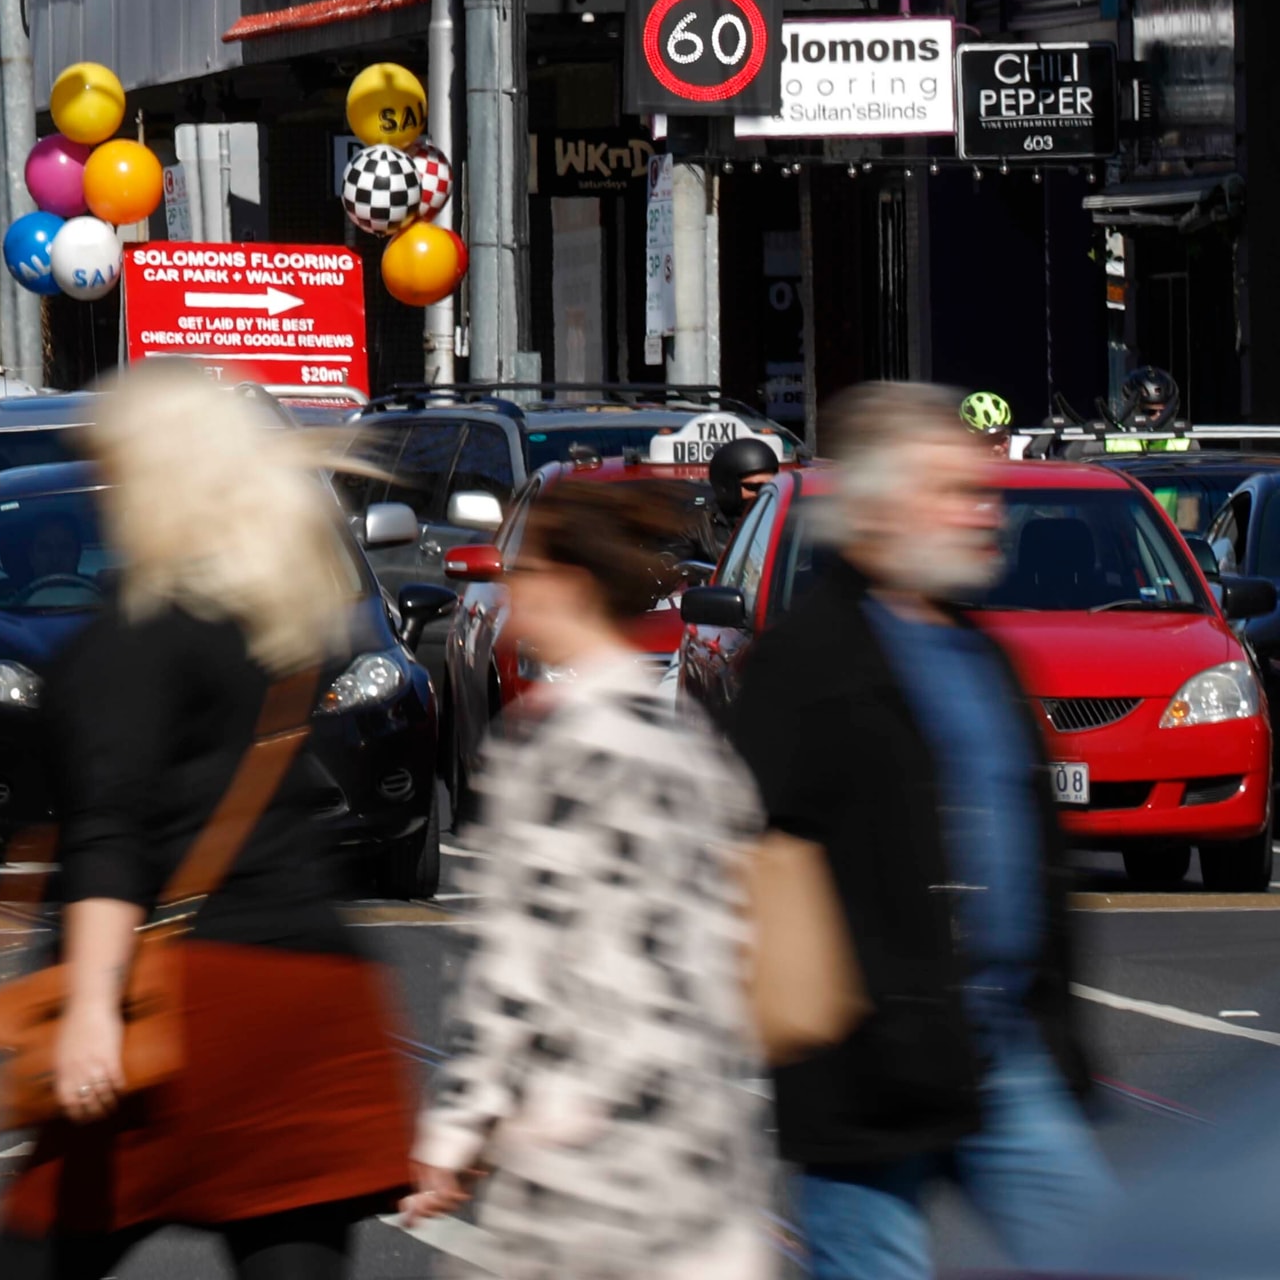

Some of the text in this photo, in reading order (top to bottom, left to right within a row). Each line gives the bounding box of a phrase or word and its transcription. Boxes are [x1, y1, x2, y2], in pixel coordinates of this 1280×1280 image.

[666, 11, 747, 66] 60
[782, 32, 940, 63] lomons
[993, 52, 1079, 85] CHILI
[785, 72, 939, 101] ooring
[979, 86, 1094, 118] PEPPER
[379, 100, 425, 133] SAL
[1023, 135, 1054, 152] 603
[133, 249, 354, 270] SOLOMONS FLOORING
[73, 263, 117, 288] SAL
[143, 269, 345, 286] CAR PARK + WALK THRU
[177, 316, 315, 332] GET LAID BY THE BEST
[140, 331, 354, 348] CHECK OUT OUR GOOGLE REVIEWS
[697, 422, 738, 442] TAXI
[674, 442, 716, 463] 13C
[1056, 768, 1083, 793] 08
